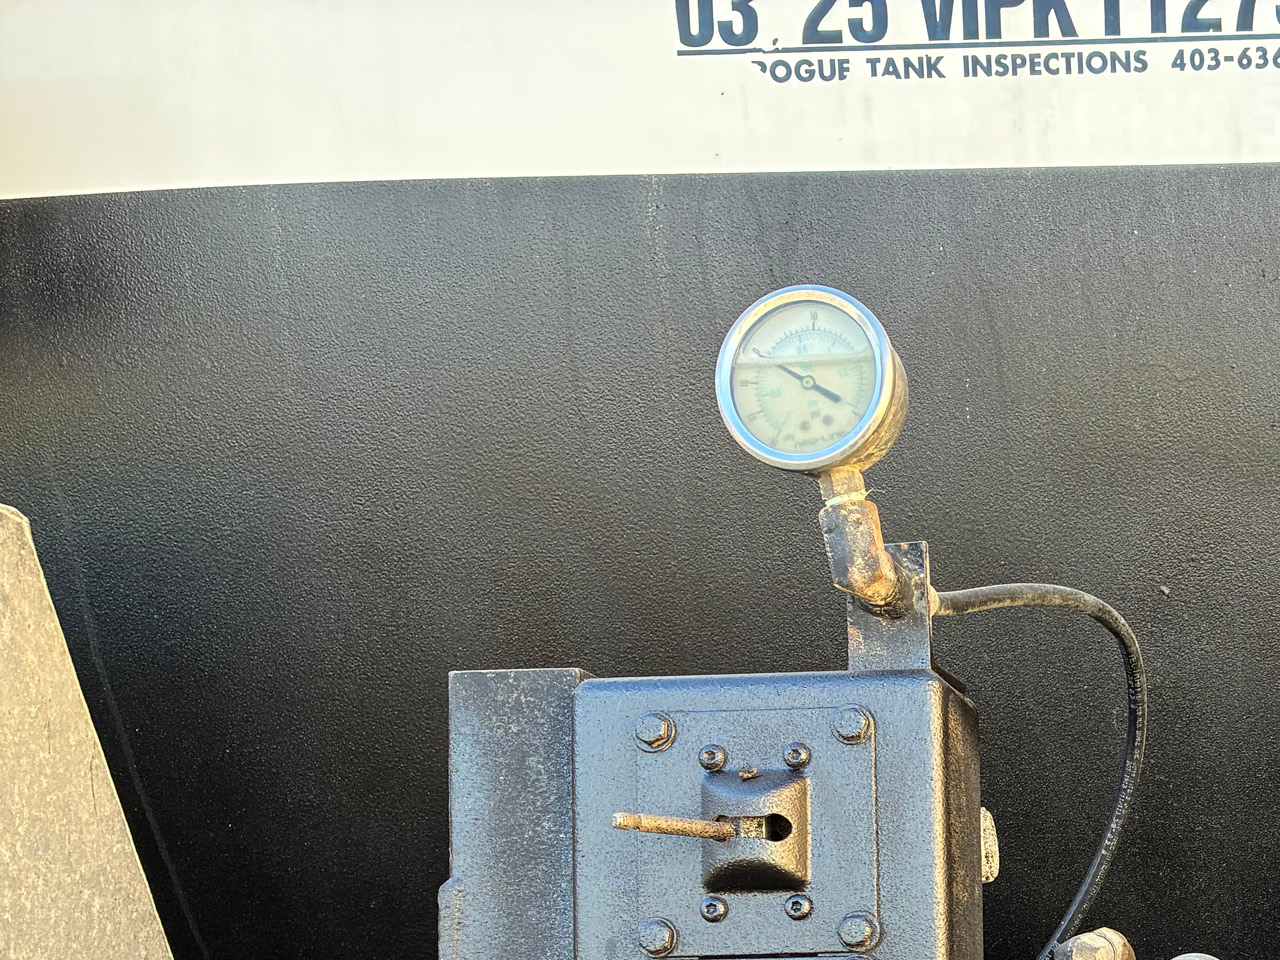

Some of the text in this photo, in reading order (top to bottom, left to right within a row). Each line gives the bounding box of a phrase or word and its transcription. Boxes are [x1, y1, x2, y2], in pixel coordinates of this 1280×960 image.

[752, 58, 850, 83] OGUE
[866, 55, 946, 80] TANK
[963, 50, 1148, 79] INSPECTIONS
